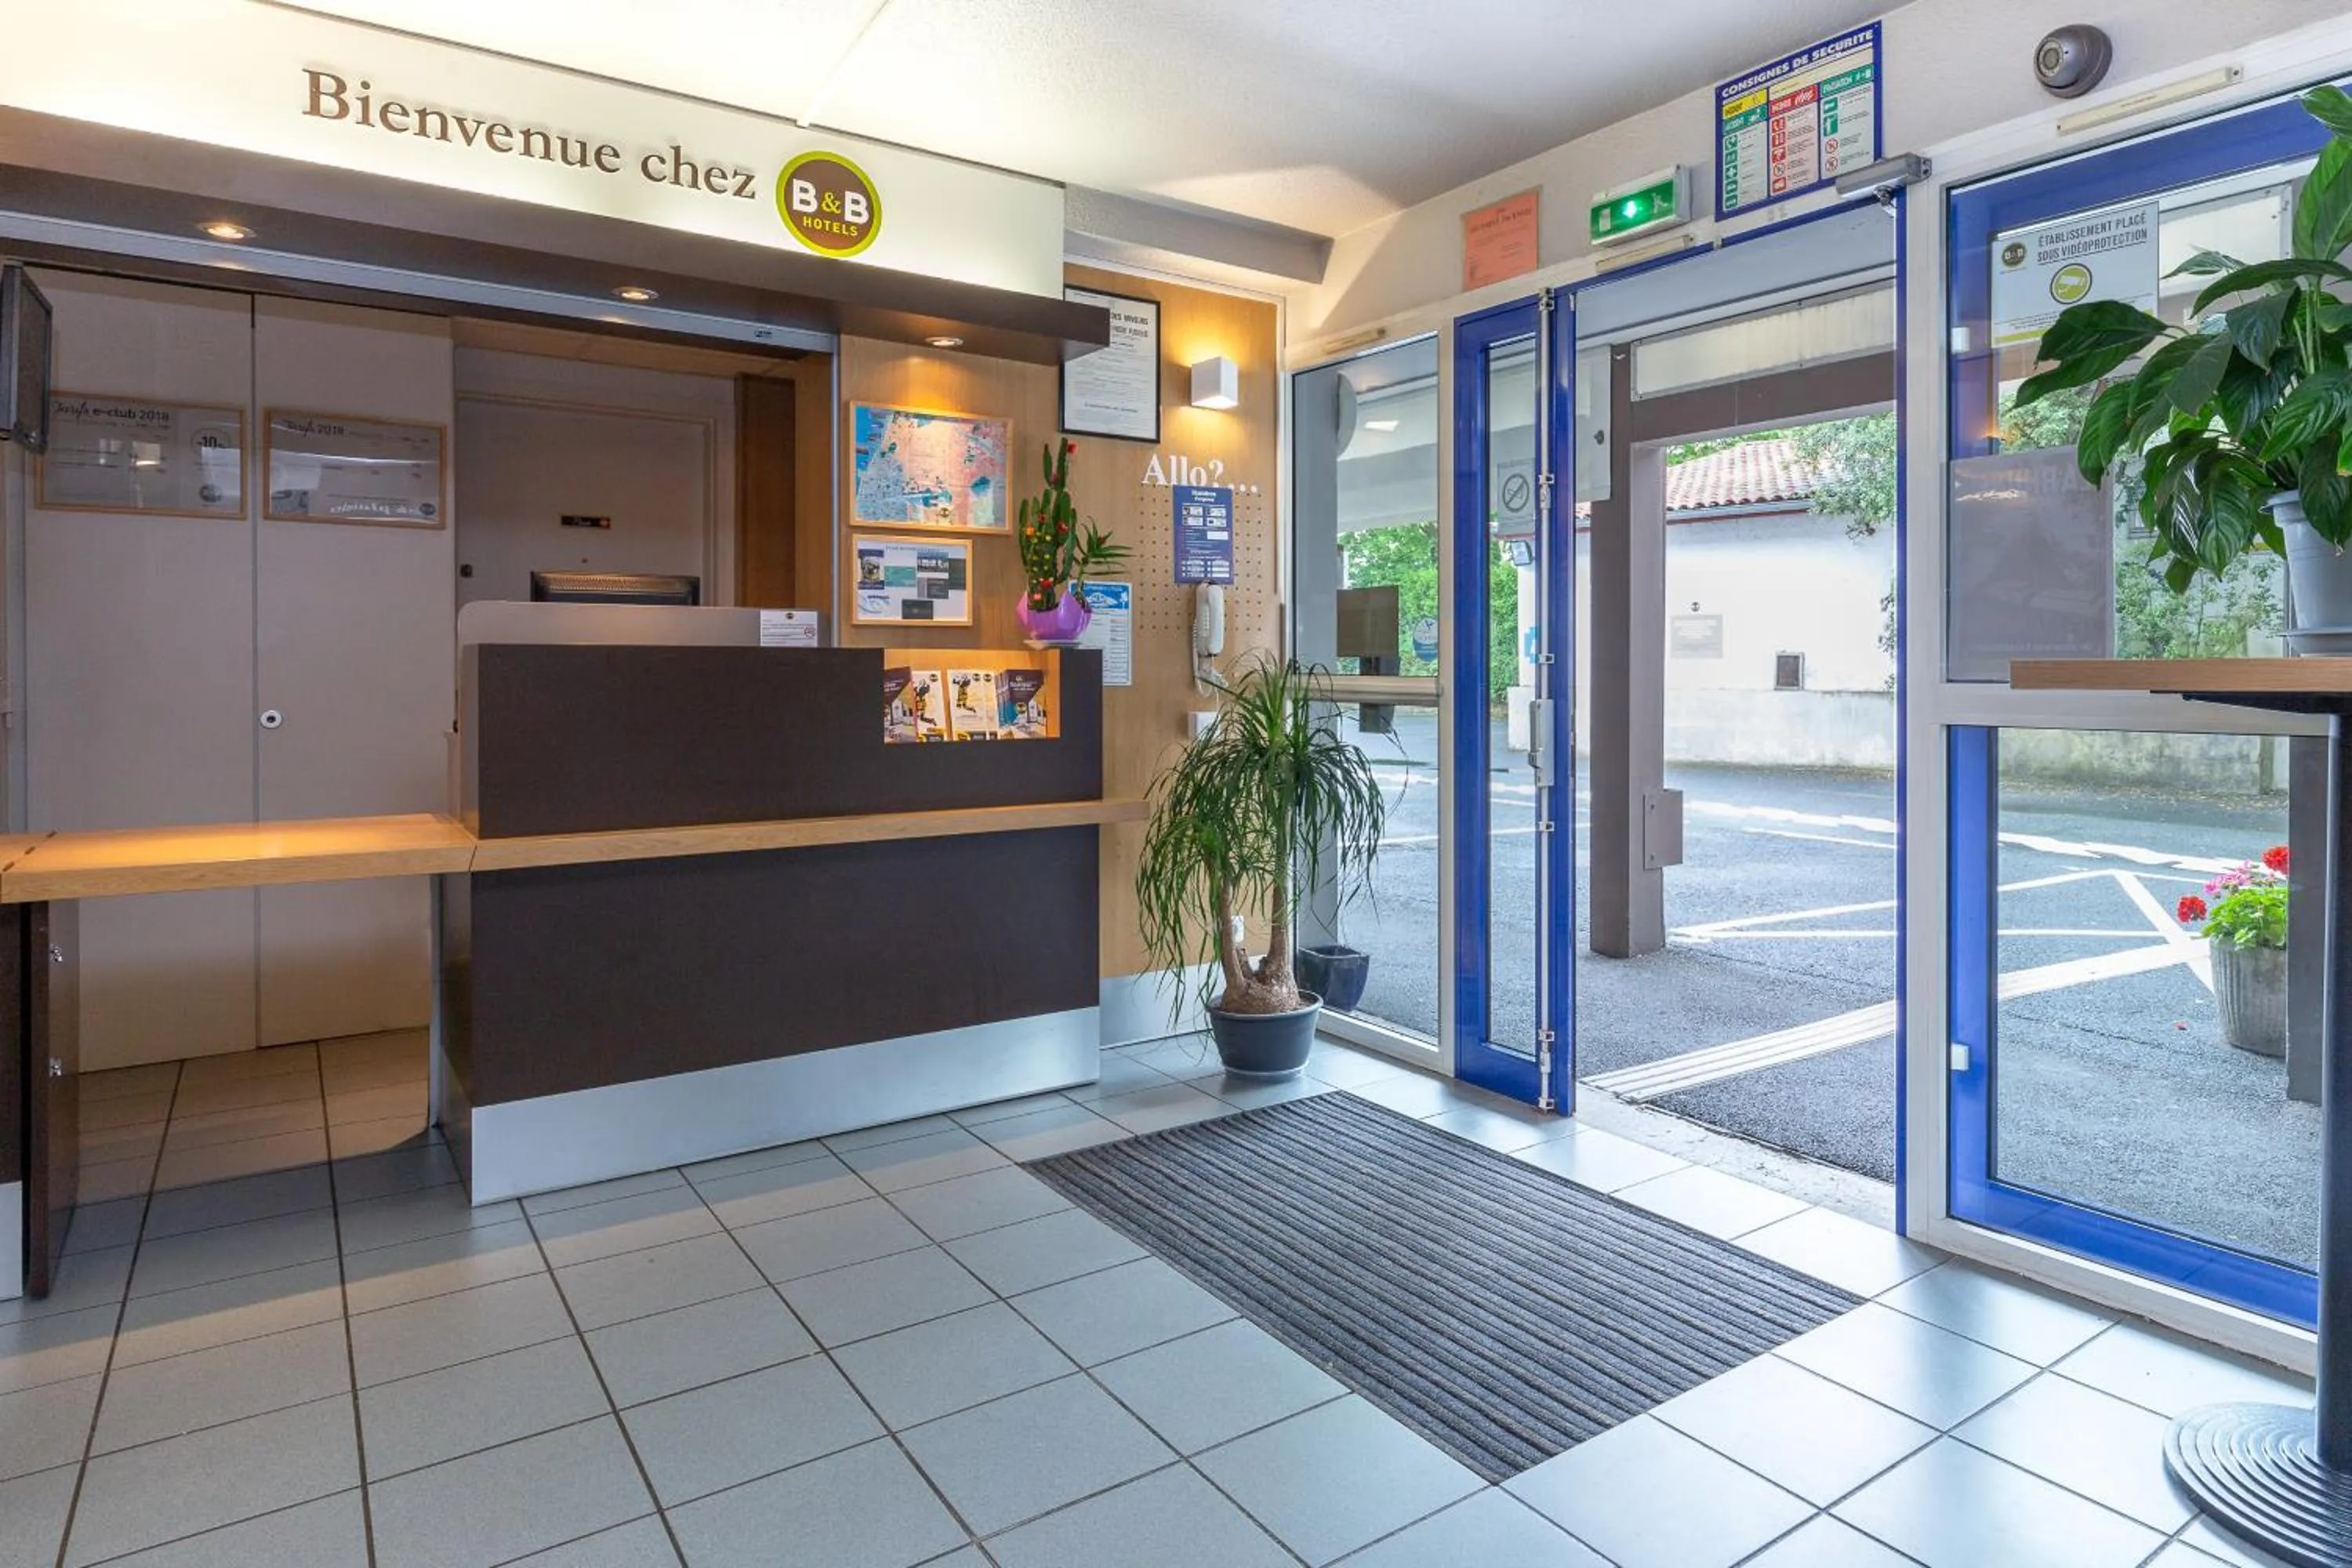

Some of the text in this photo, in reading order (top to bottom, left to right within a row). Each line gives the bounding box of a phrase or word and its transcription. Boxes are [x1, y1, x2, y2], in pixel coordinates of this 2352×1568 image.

[1721, 62, 1791, 98] CONSIGNES
[1792, 53, 1809, 70] DE
[300, 67, 757, 200] Bienvenue chez
[792, 178, 870, 225] B&B
[802, 216, 858, 237] HOTELS
[2115, 209, 2147, 230] PLACÉ
[2037, 248, 2060, 263] SOUS
